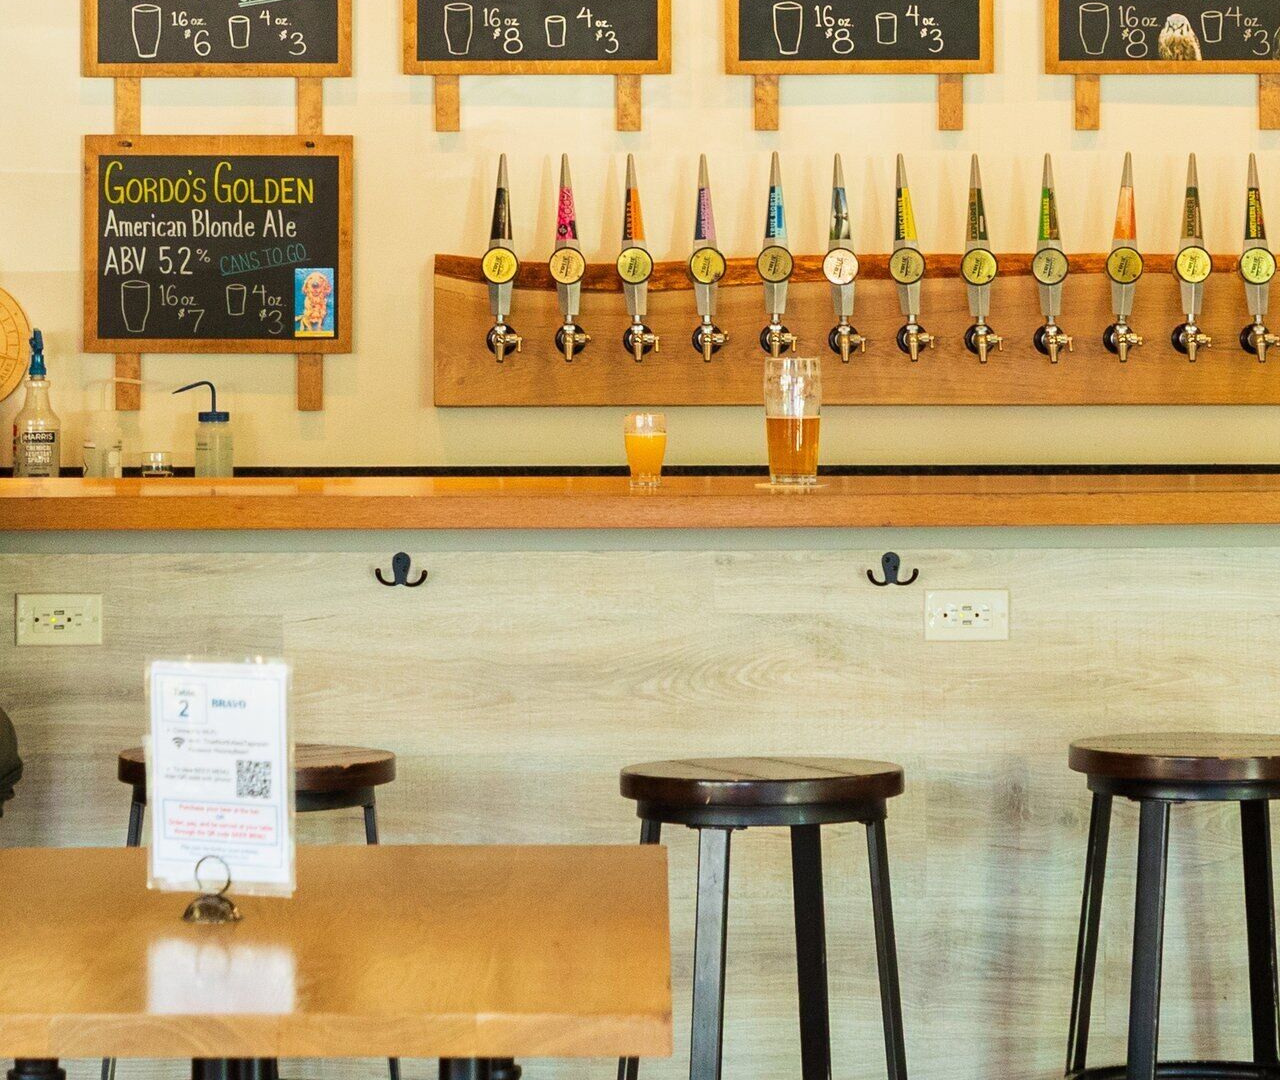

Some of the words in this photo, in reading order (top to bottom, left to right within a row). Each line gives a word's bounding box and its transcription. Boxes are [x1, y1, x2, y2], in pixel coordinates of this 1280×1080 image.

[104, 161, 207, 204] GORDO'S
[214, 161, 314, 204] GOLDEN
[104, 209, 187, 238] American
[192, 209, 255, 238] Blonde
[263, 209, 297, 238] Ale
